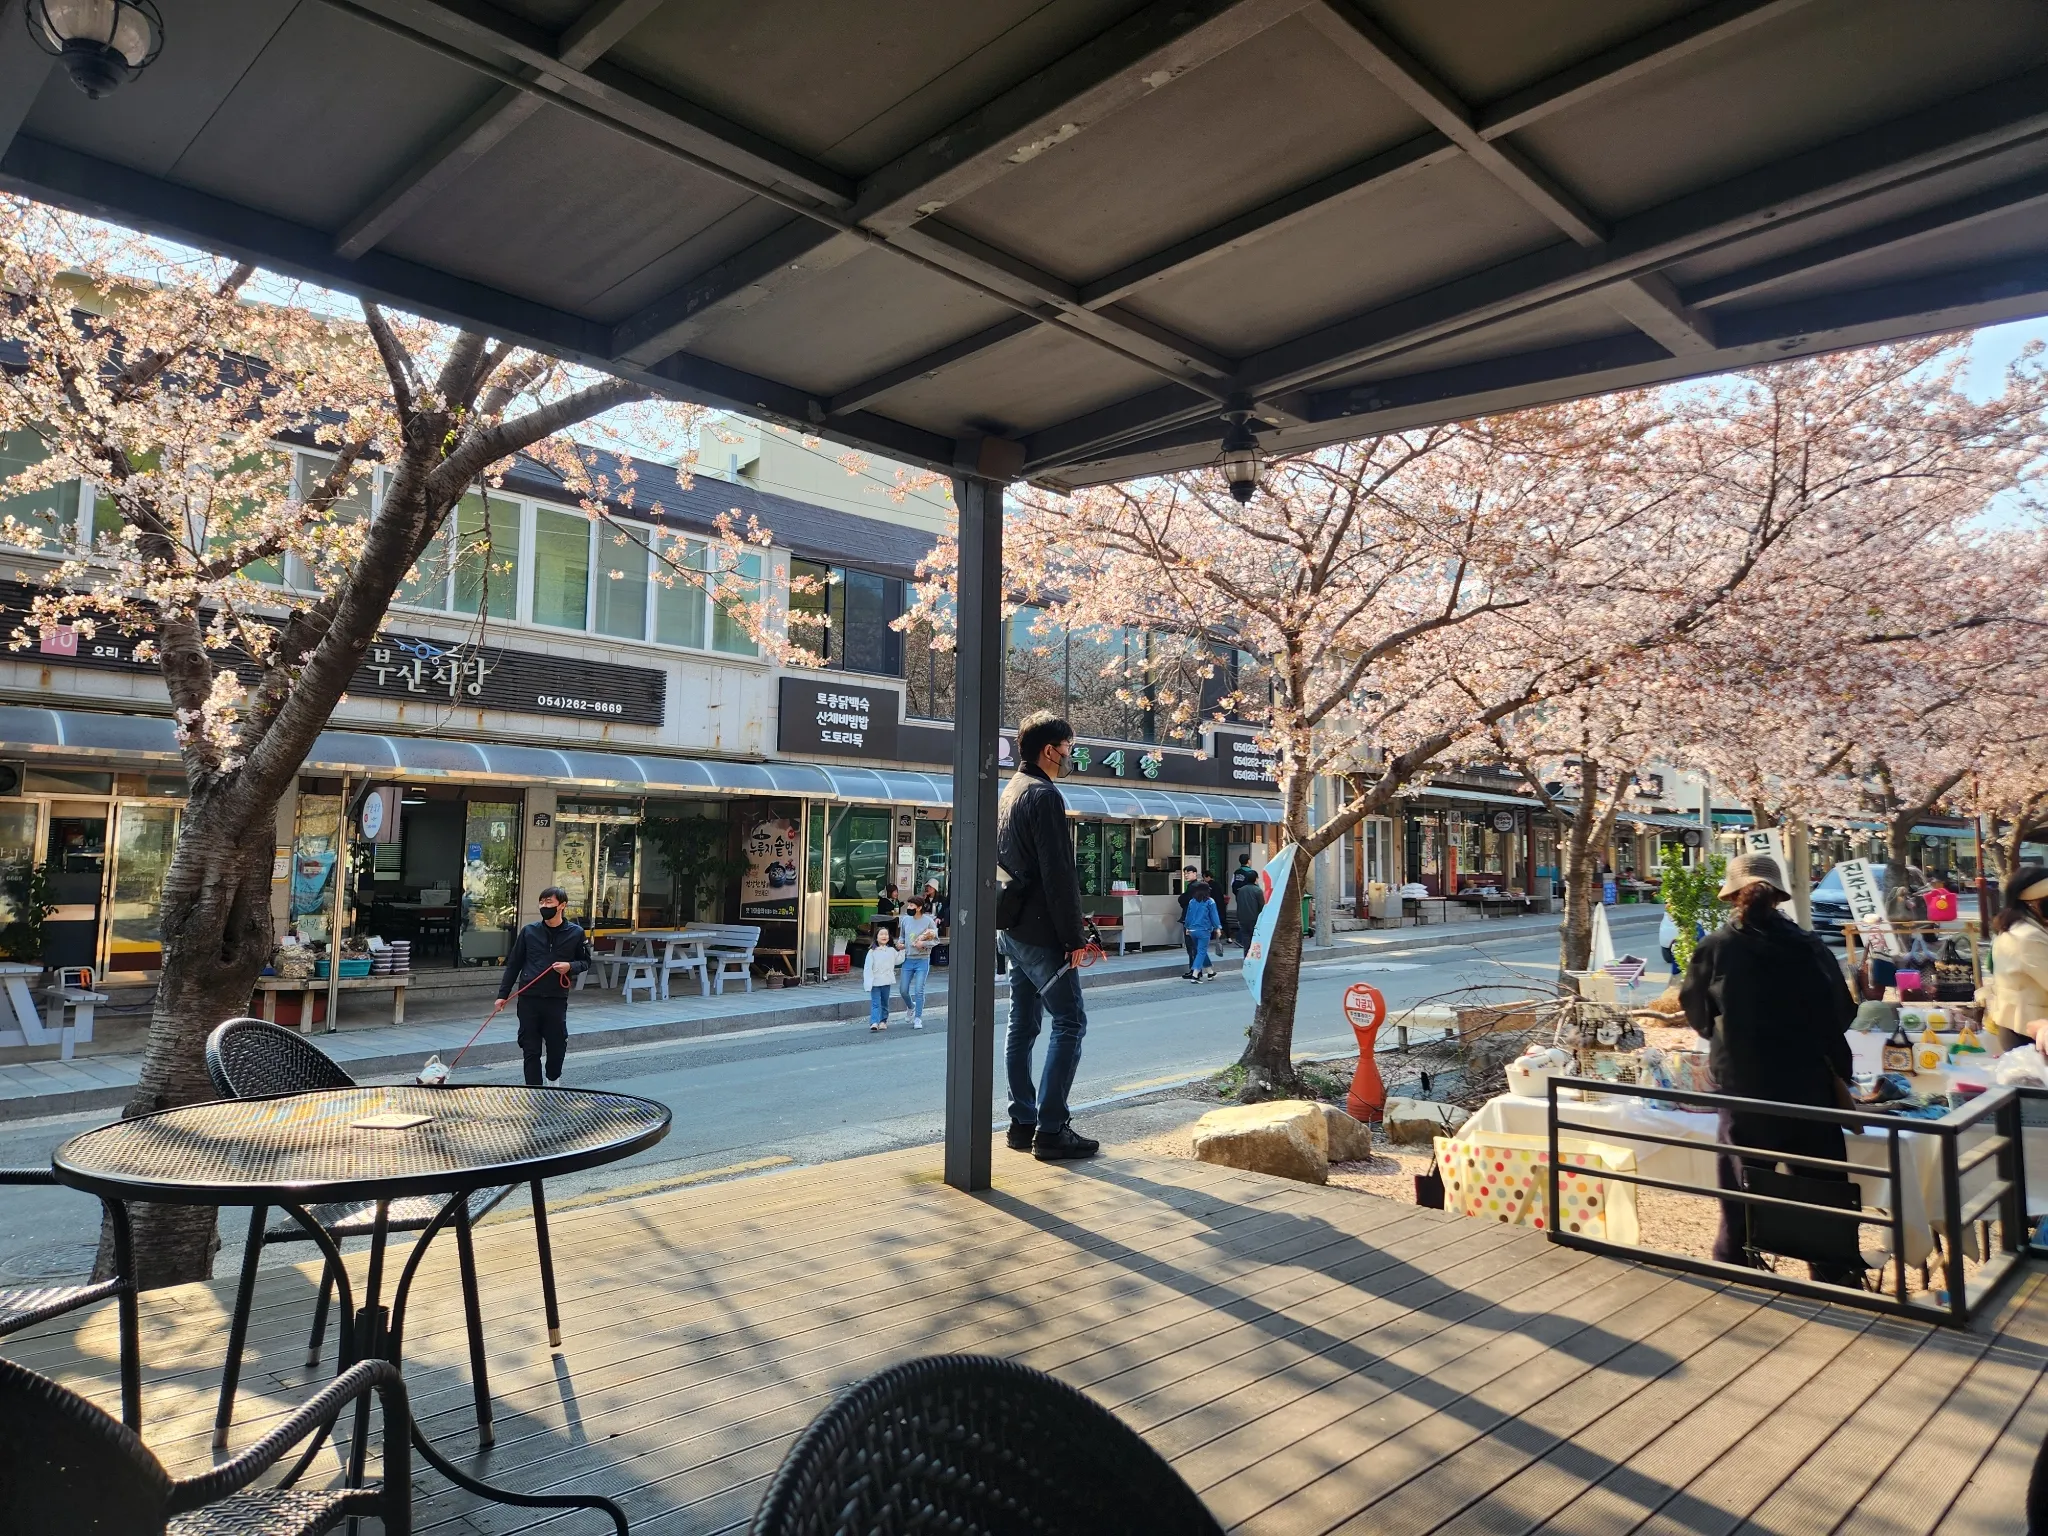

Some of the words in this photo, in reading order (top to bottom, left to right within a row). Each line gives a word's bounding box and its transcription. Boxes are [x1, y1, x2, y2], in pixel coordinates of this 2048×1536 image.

[366, 648, 486, 697] 부산식당
[537, 695, 623, 714] 054)262-6669
[816, 692, 870, 713] 토종닭백숙
[815, 711, 870, 731] 산채비빔밥
[820, 730, 864, 748] 도토리묵
[535, 819, 549, 827] 457
[749, 841, 773, 858] 누룽지
[775, 835, 795, 857] 솥밥
[1841, 861, 1877, 922] 진주식당
